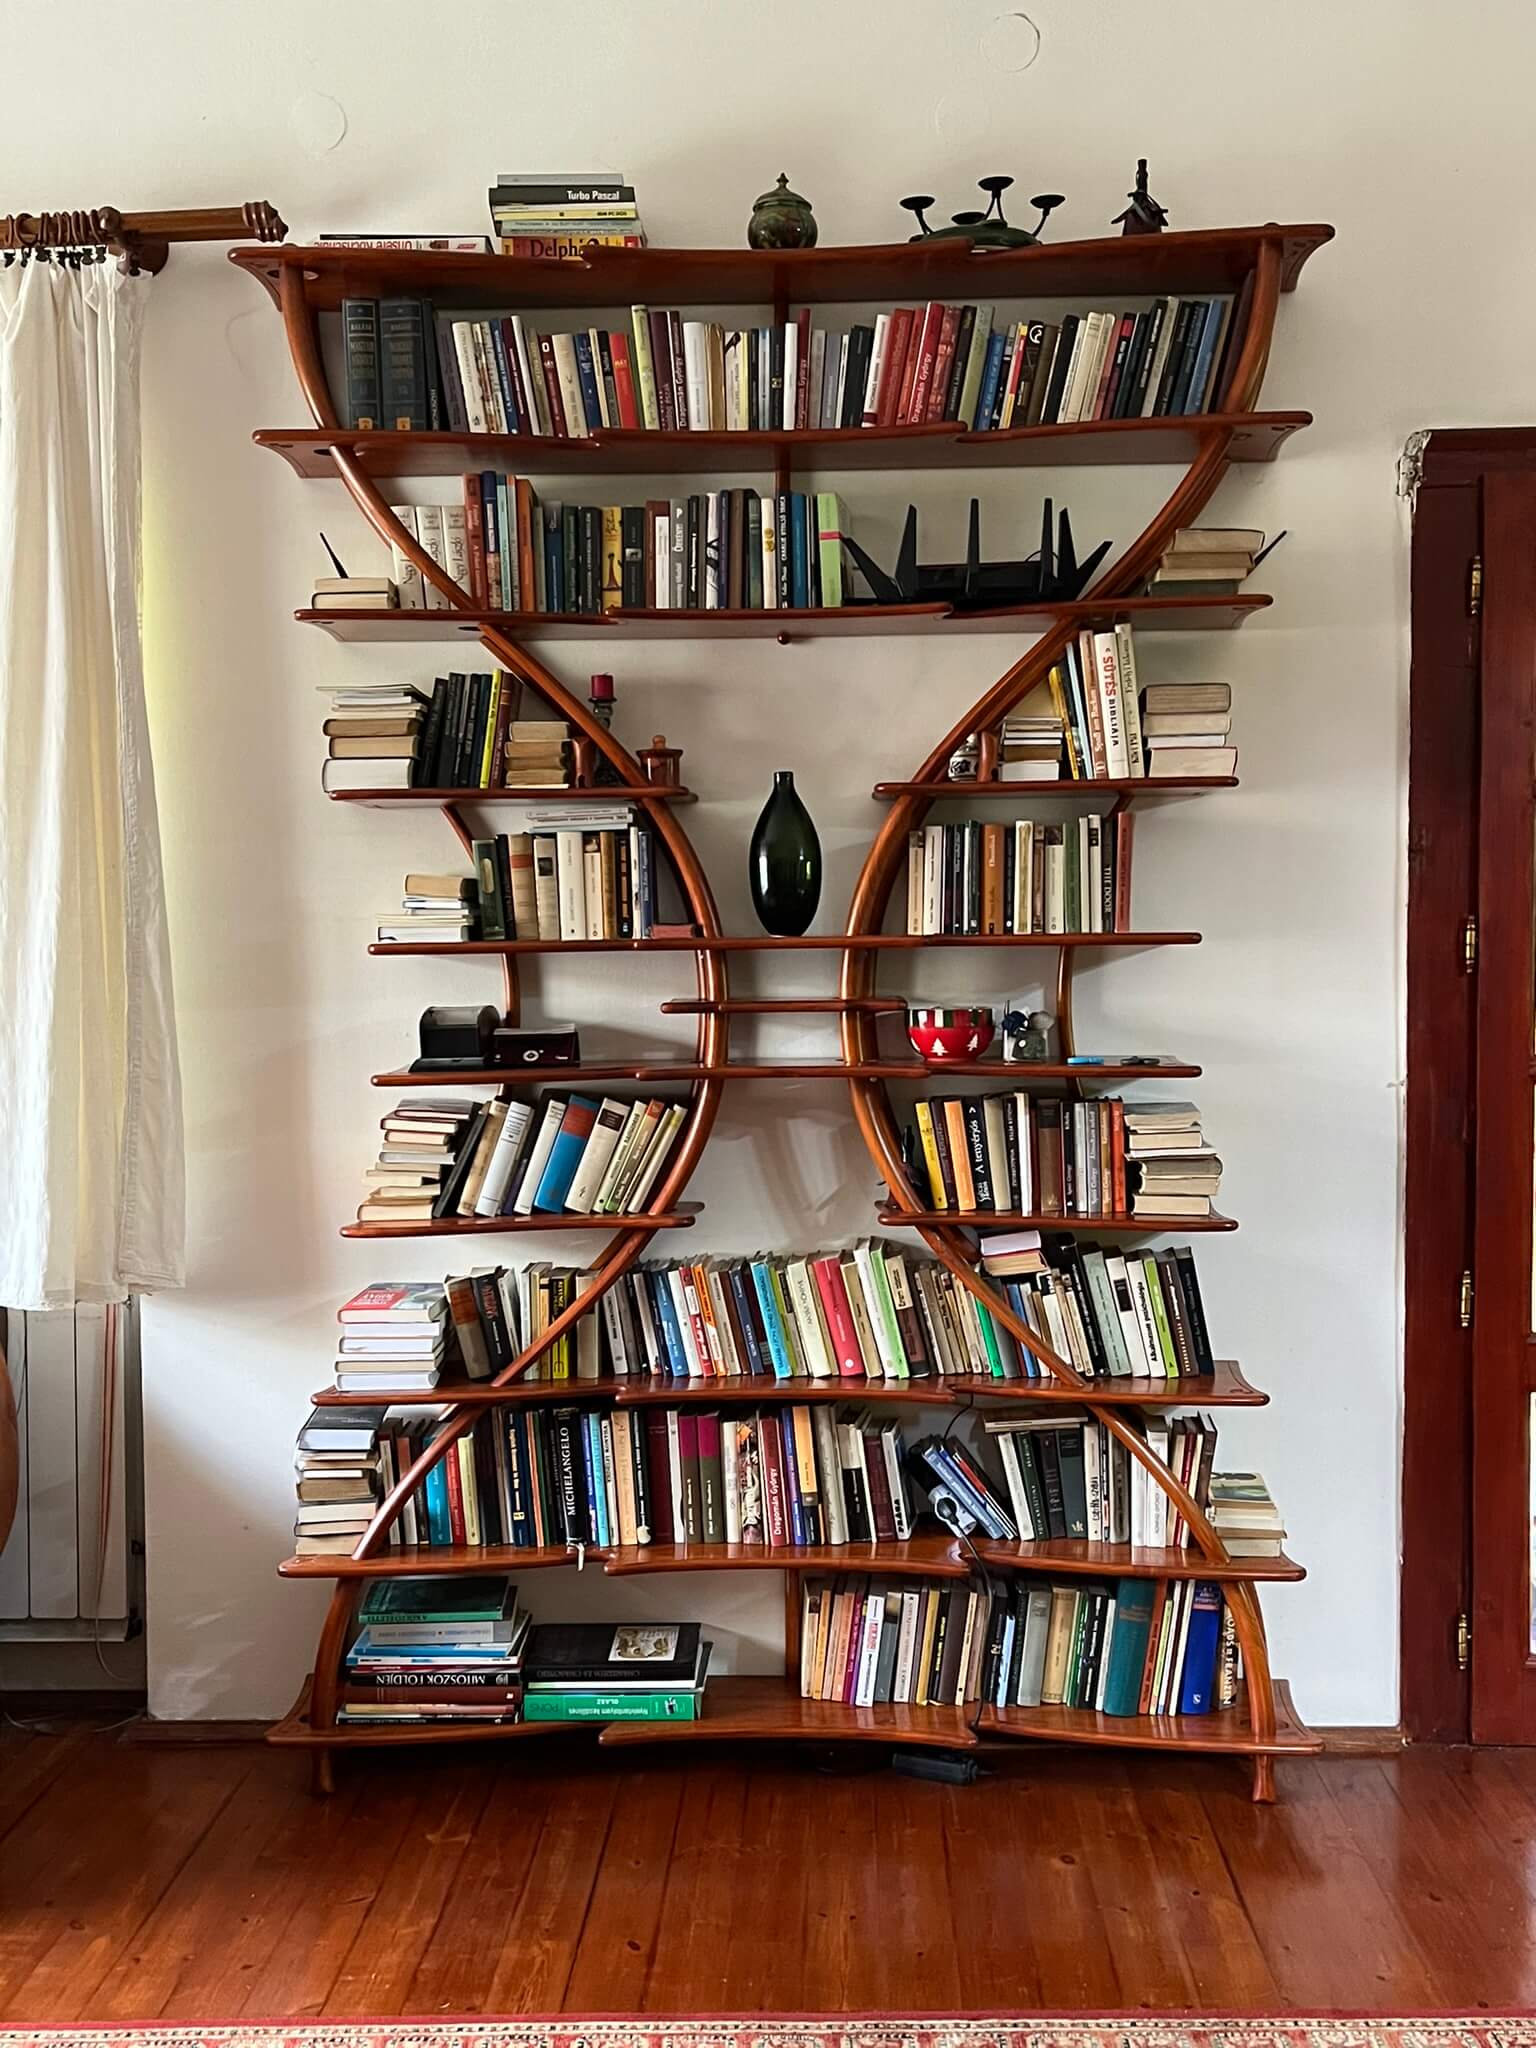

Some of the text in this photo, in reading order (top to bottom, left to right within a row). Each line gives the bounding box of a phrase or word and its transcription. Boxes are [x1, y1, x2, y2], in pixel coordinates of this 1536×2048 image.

[567, 190, 620, 201] Turbo Pascal
[530, 238, 584, 260] Delphi
[675, 357, 687, 427] Dragomán György
[911, 352, 931, 423] Dragomán György
[1102, 655, 1117, 697] SÜTÉS
[1108, 698, 1120, 747] BIBLIÁJA
[1103, 887, 1112, 913] DOOR
[558, 1427, 576, 1516] MICHELANGELO
[770, 1467, 783, 1535] Dragomán György
[1222, 1657, 1234, 1705] FRANZEN
